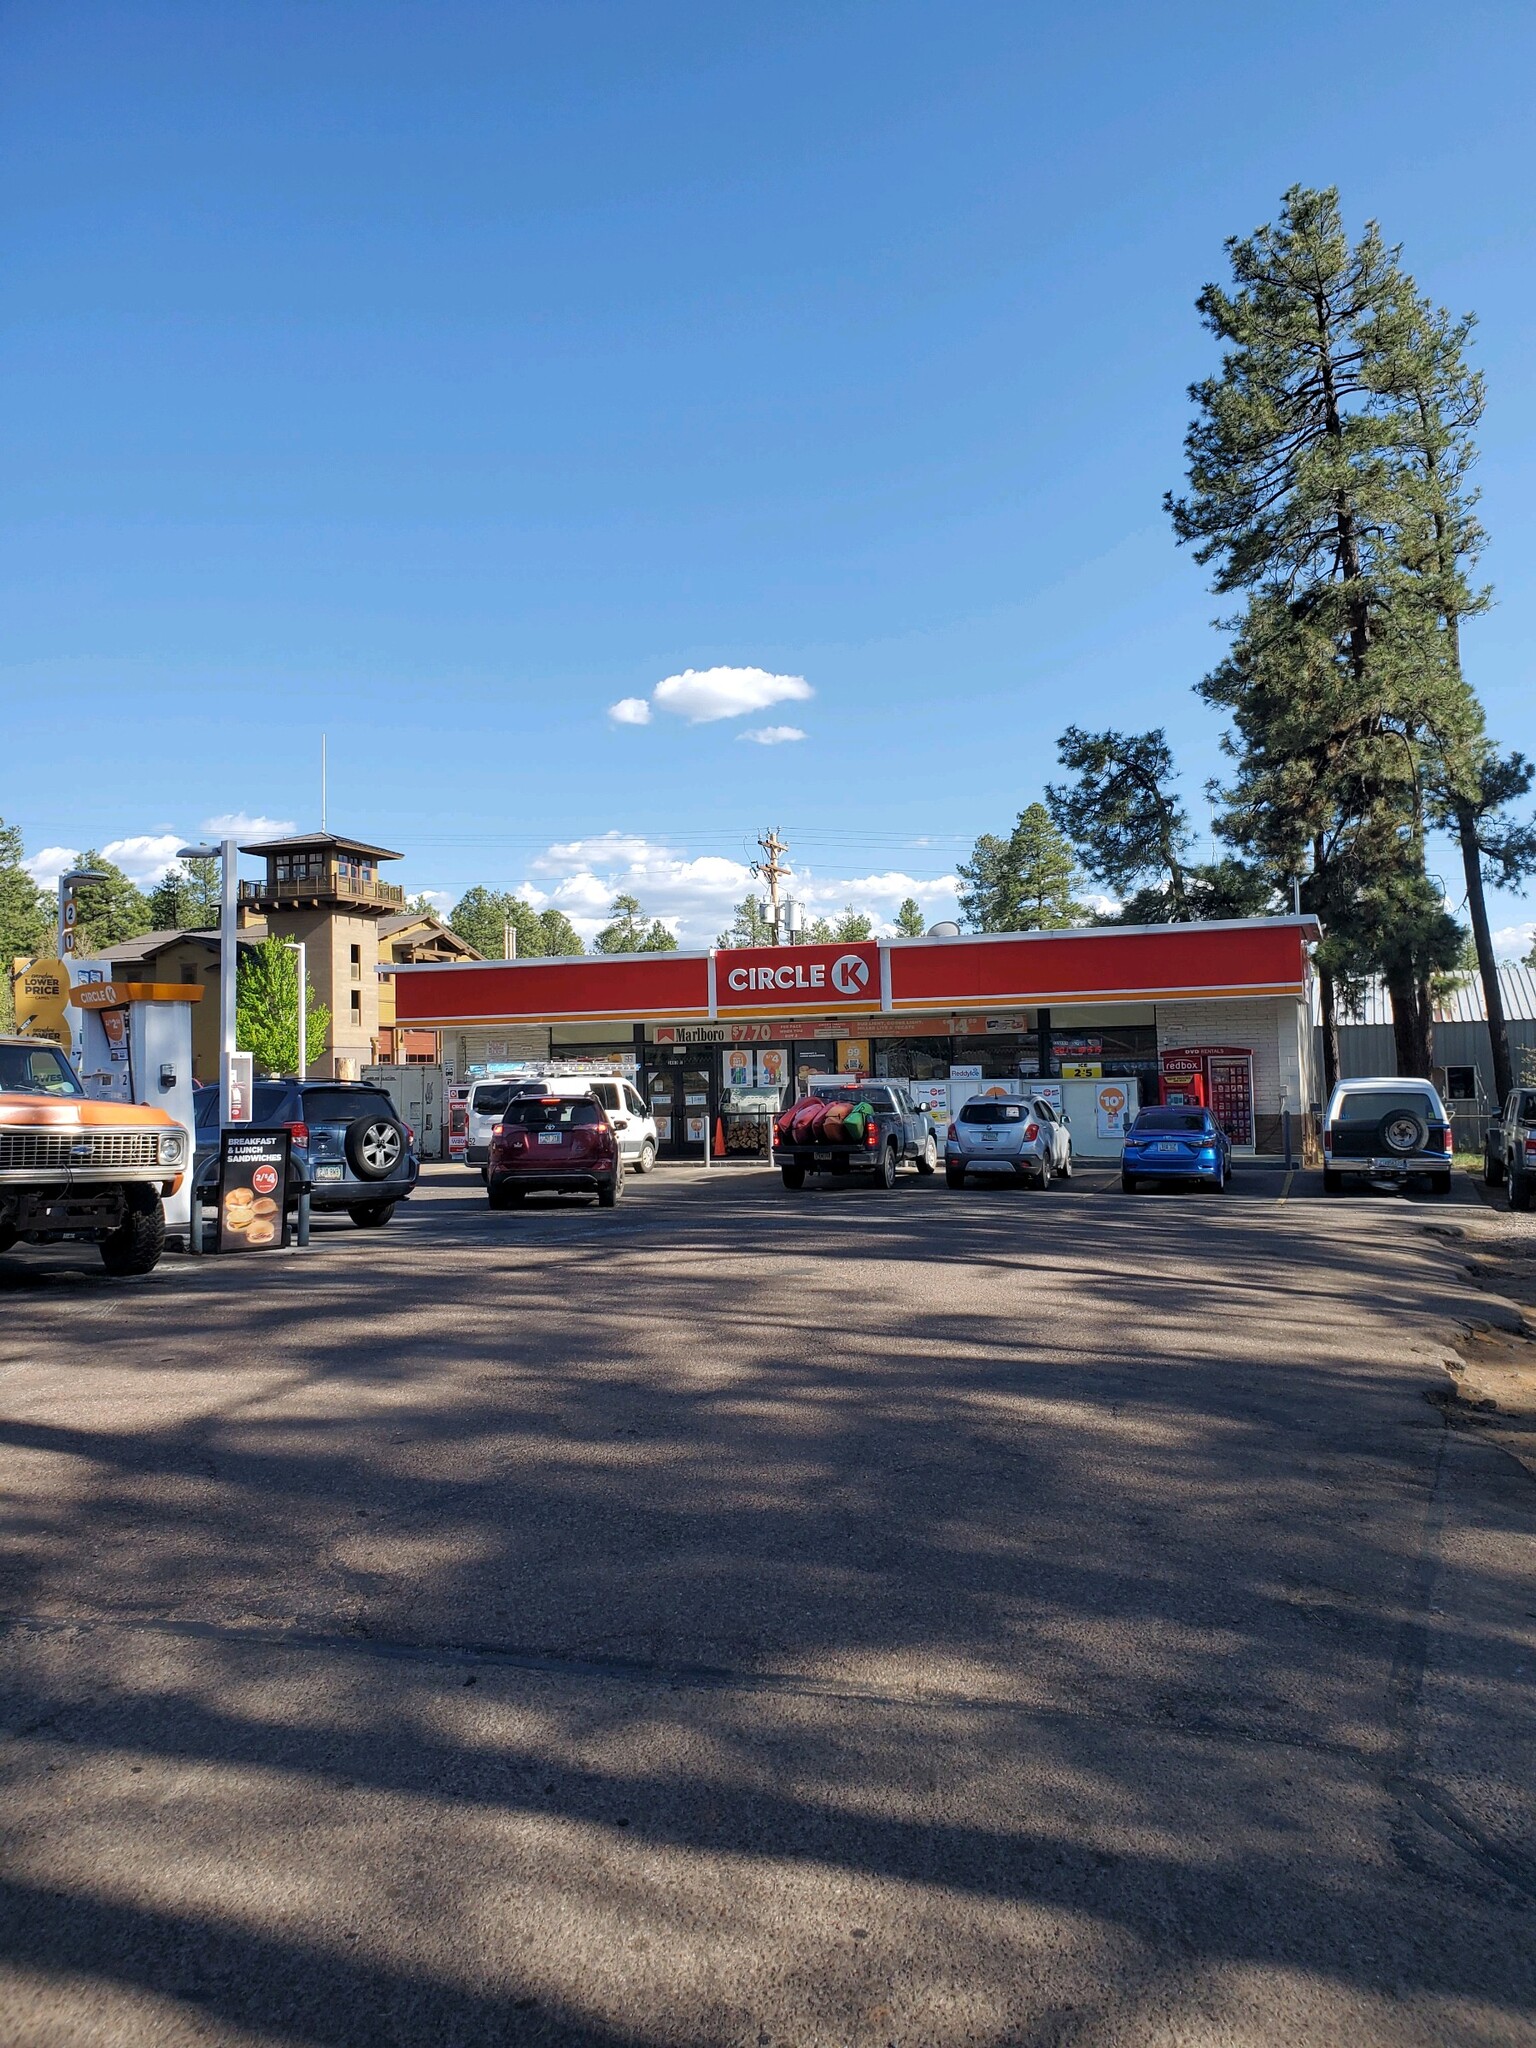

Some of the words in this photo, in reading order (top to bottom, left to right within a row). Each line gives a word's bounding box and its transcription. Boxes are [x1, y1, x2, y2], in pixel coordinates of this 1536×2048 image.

[68, 907, 73, 920] 2
[67, 934, 72, 948] 1
[728, 964, 826, 991] CIRCLE
[837, 958, 869, 994] K
[24, 986, 60, 995] PRICE
[80, 990, 106, 1004] CIRCLE
[105, 985, 117, 1004] K
[675, 1027, 725, 1043] Marlboro
[732, 1024, 772, 1041] $7.70
[1165, 1061, 1198, 1071] redbox
[951, 1069, 979, 1078] ReddyIce
[122, 1074, 127, 1085] 2
[228, 1138, 277, 1146] BREAKFAST
[235, 1146, 264, 1154] LUNCH
[227, 1154, 282, 1163] SANDWICHES
